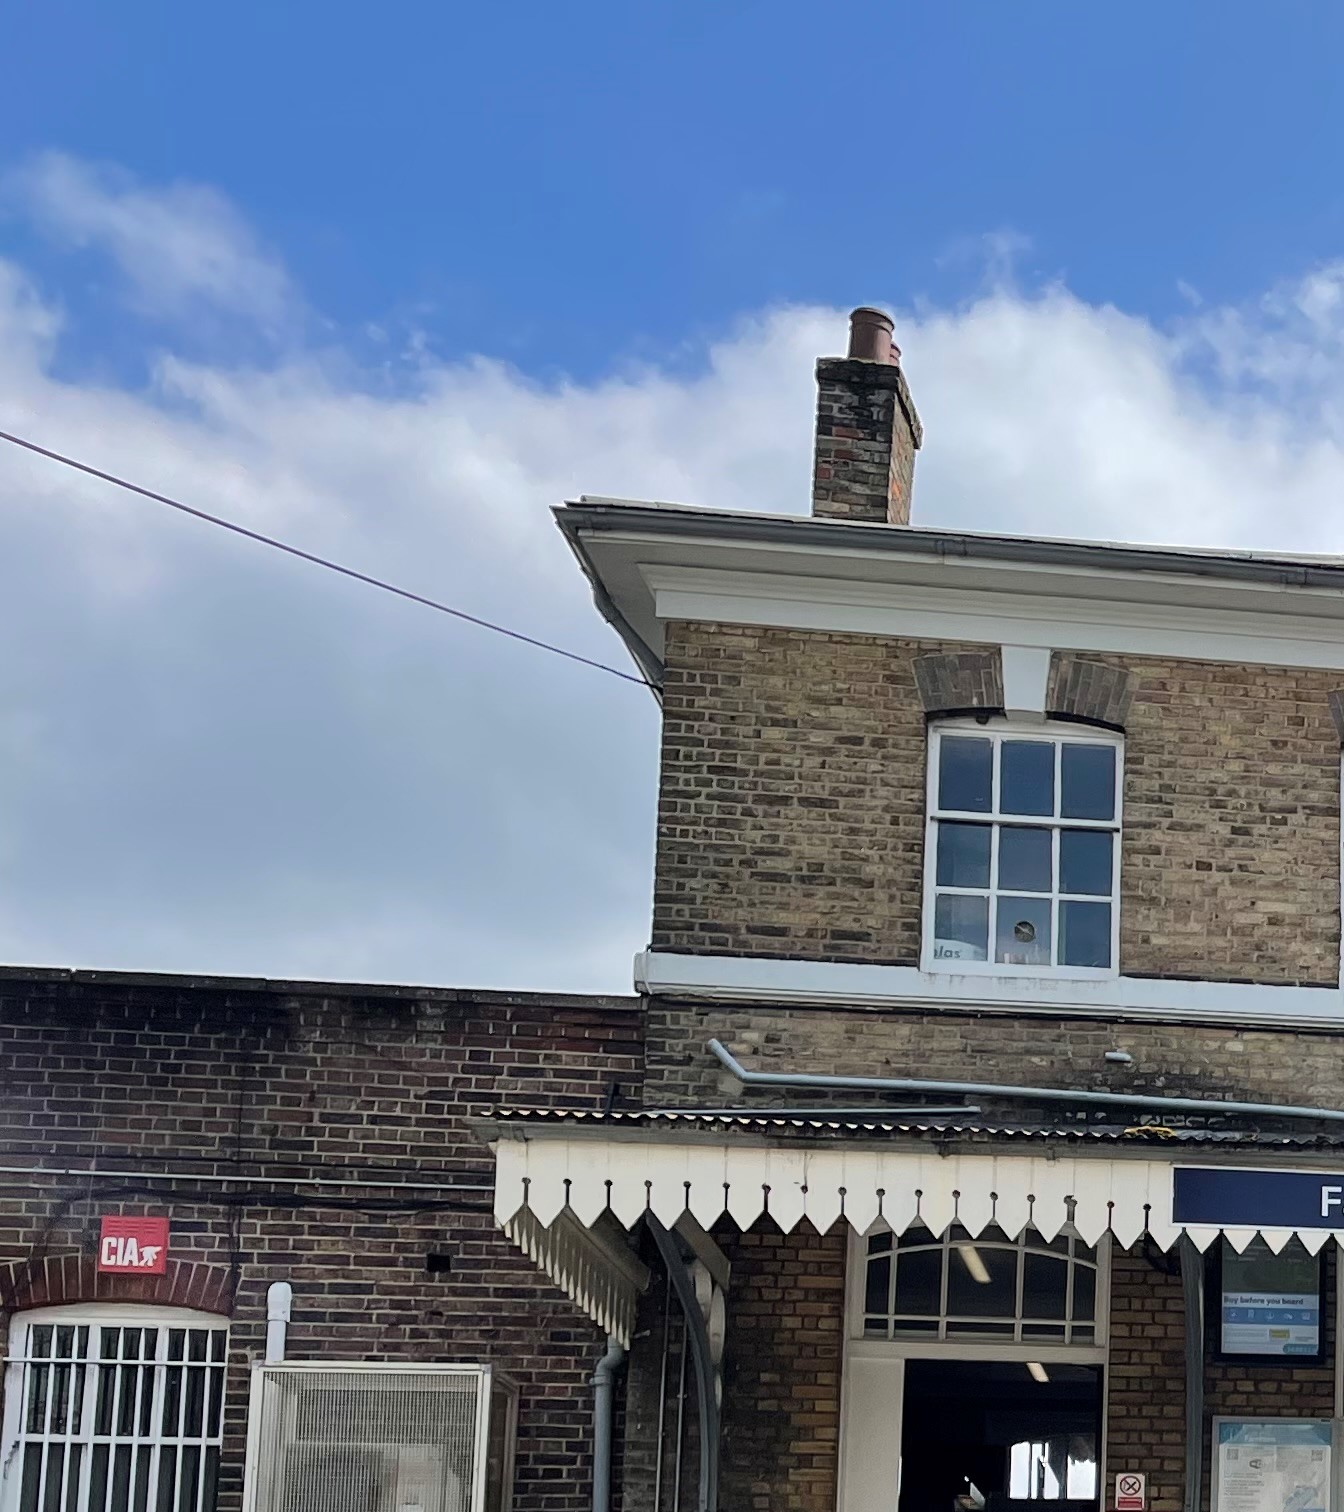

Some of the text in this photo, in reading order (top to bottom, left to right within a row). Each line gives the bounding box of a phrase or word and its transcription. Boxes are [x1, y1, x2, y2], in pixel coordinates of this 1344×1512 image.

[101, 1236, 139, 1266] CIA
[1240, 1296, 1265, 1304] before
[1266, 1298, 1281, 1306] you
[1282, 1298, 1304, 1306] board
